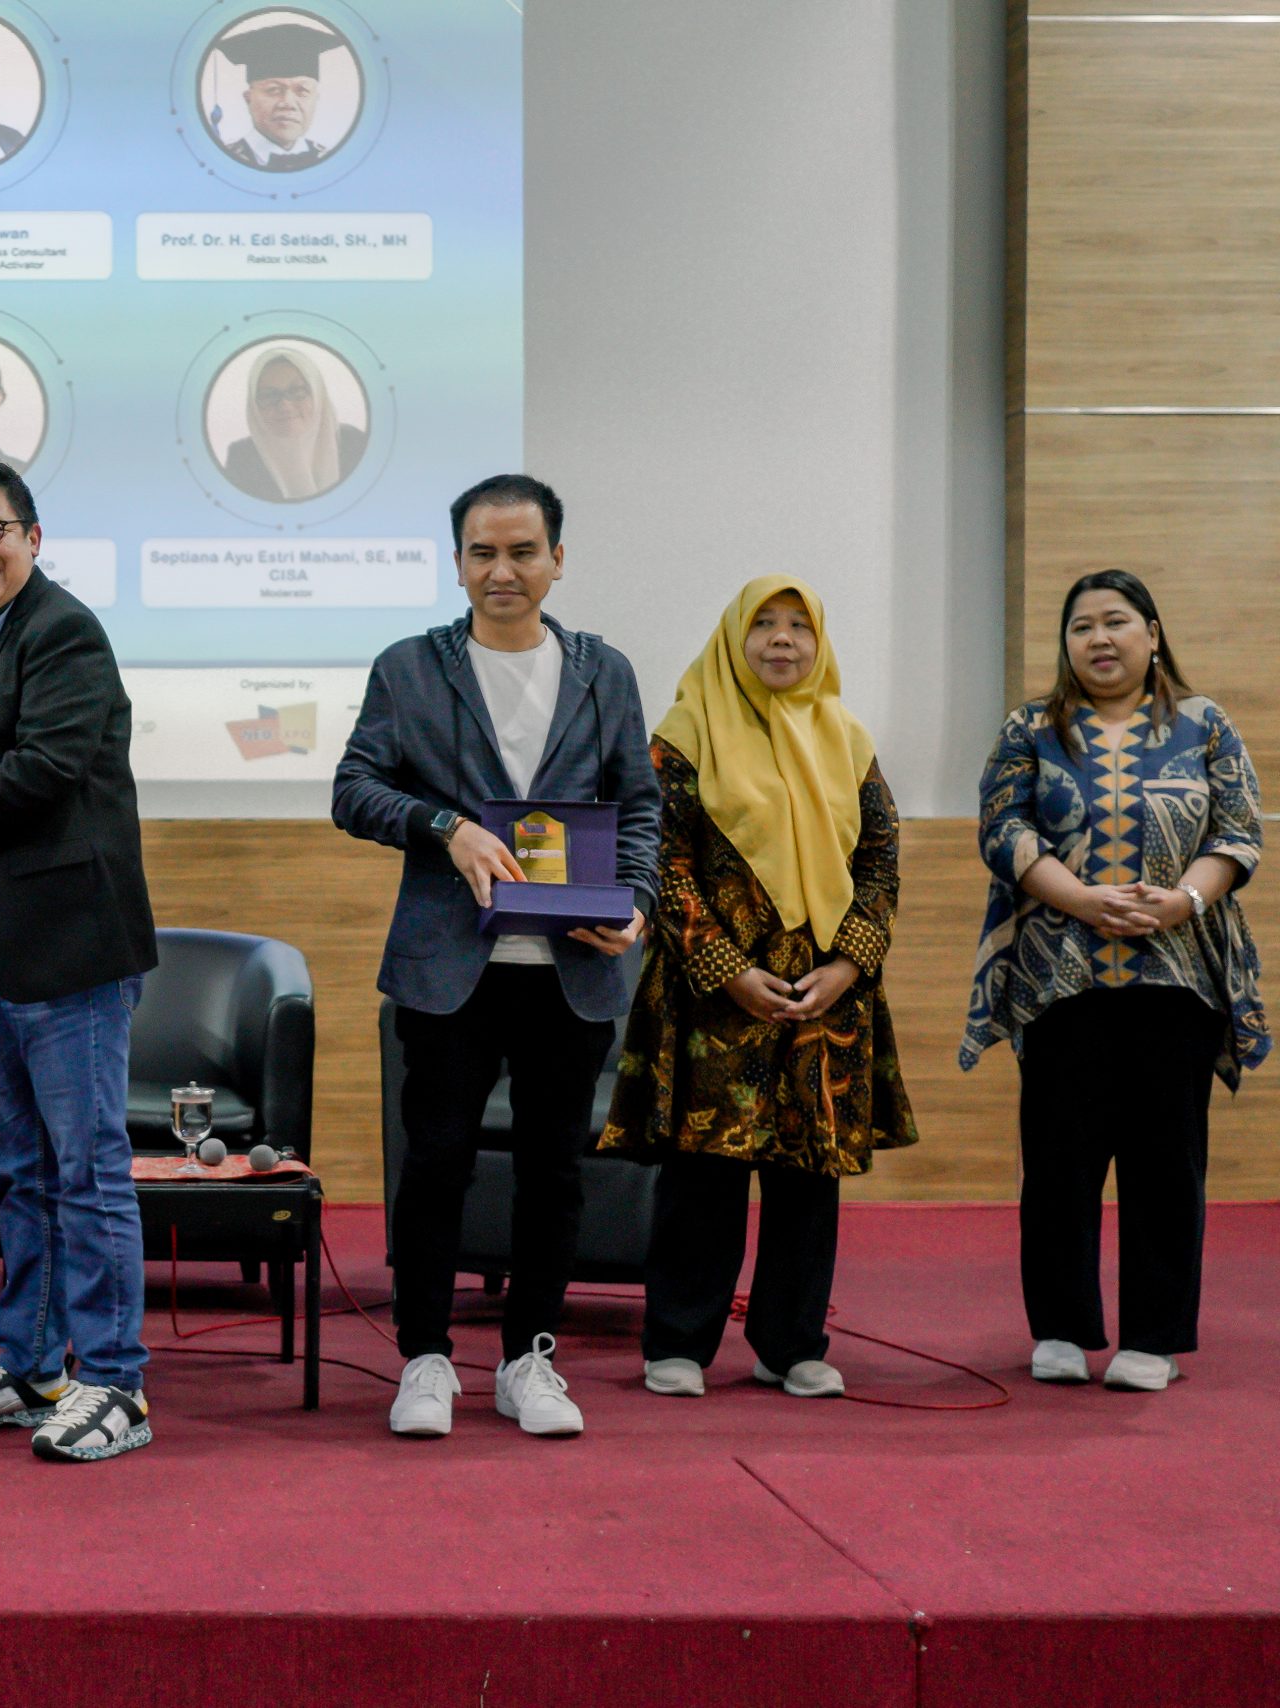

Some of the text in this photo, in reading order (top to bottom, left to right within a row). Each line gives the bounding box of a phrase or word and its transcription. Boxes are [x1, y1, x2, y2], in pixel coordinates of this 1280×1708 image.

[161, 234, 407, 248] Prof. Dr. H. Edi Setiadi, SH., MH
[11, 248, 66, 256] Consultant
[247, 255, 280, 264] Rektor
[0, 261, 44, 270] Activator
[150, 550, 428, 566] Septiana Ayu Estri Mahani, SE, MM,
[269, 569, 308, 581] CISA
[260, 588, 312, 598] Moderator
[240, 679, 295, 691] Organized
